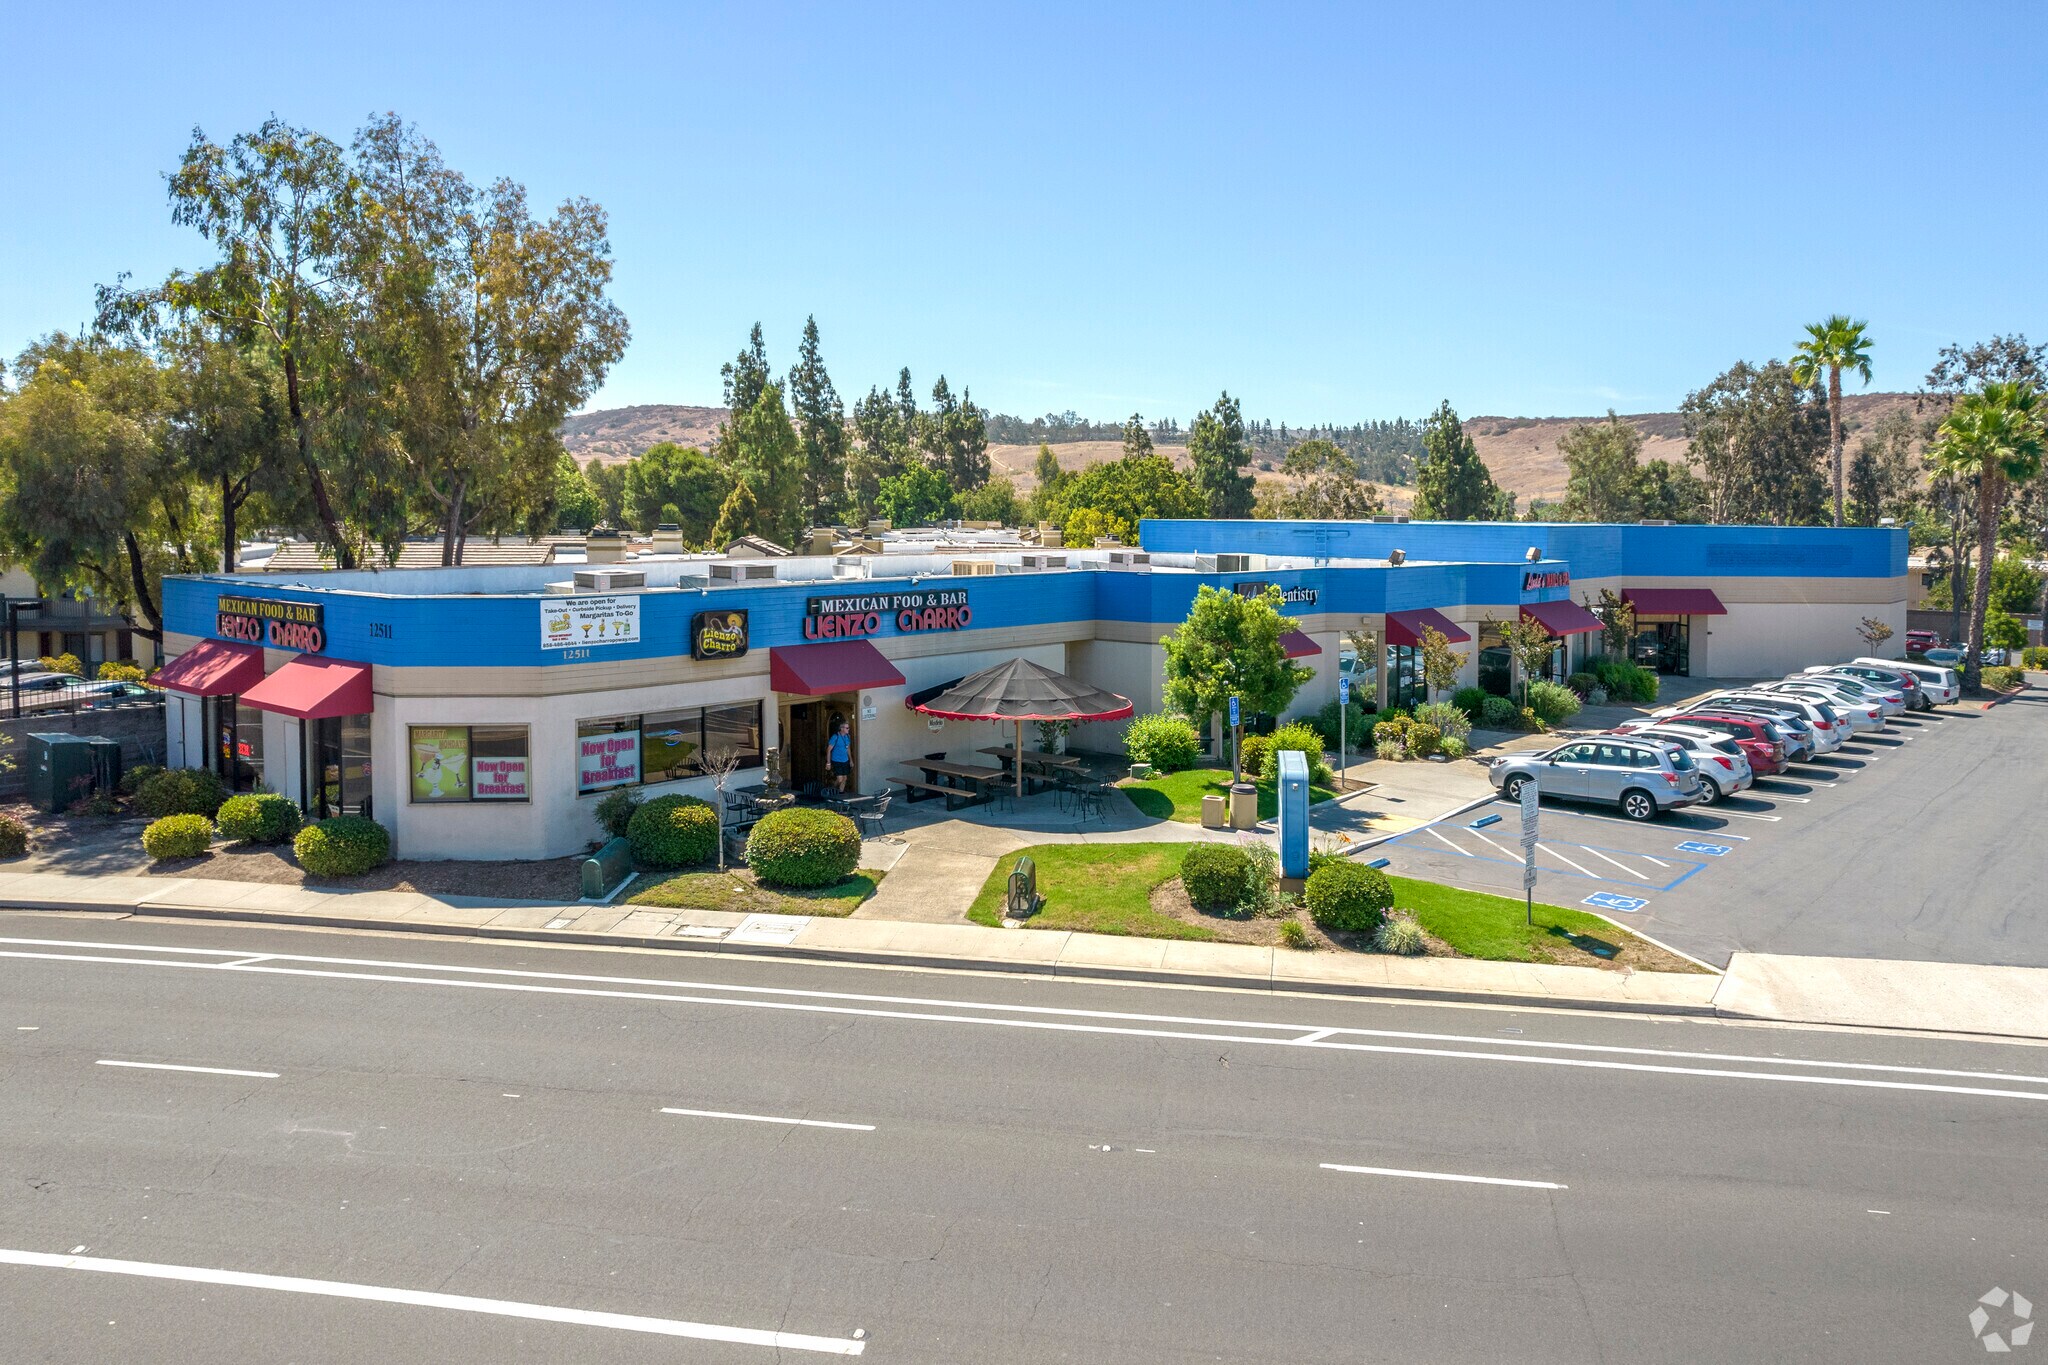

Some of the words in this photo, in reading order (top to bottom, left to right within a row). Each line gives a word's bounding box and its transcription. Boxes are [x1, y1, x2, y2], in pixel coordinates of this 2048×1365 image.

[821, 596, 889, 613] MEXICAN
[926, 593, 937, 606] &
[940, 591, 968, 605] BAR
[218, 598, 258, 617] MEXICAN
[259, 602, 284, 619] FOOD
[285, 606, 294, 620] &
[295, 606, 316, 623] BAR
[369, 622, 392, 639] 12511
[804, 612, 881, 640] LIENZO
[703, 628, 736, 641] Lienzo
[703, 638, 736, 651] Charro
[563, 649, 590, 660] 12511
[581, 741, 606, 757] Now
[607, 736, 635, 753] Open
[477, 761, 499, 772] Now
[499, 761, 525, 773] Open
[600, 753, 617, 767] for
[493, 772, 509, 783] for
[582, 765, 635, 785] Breakfast
[478, 783, 525, 794] Breakfast
